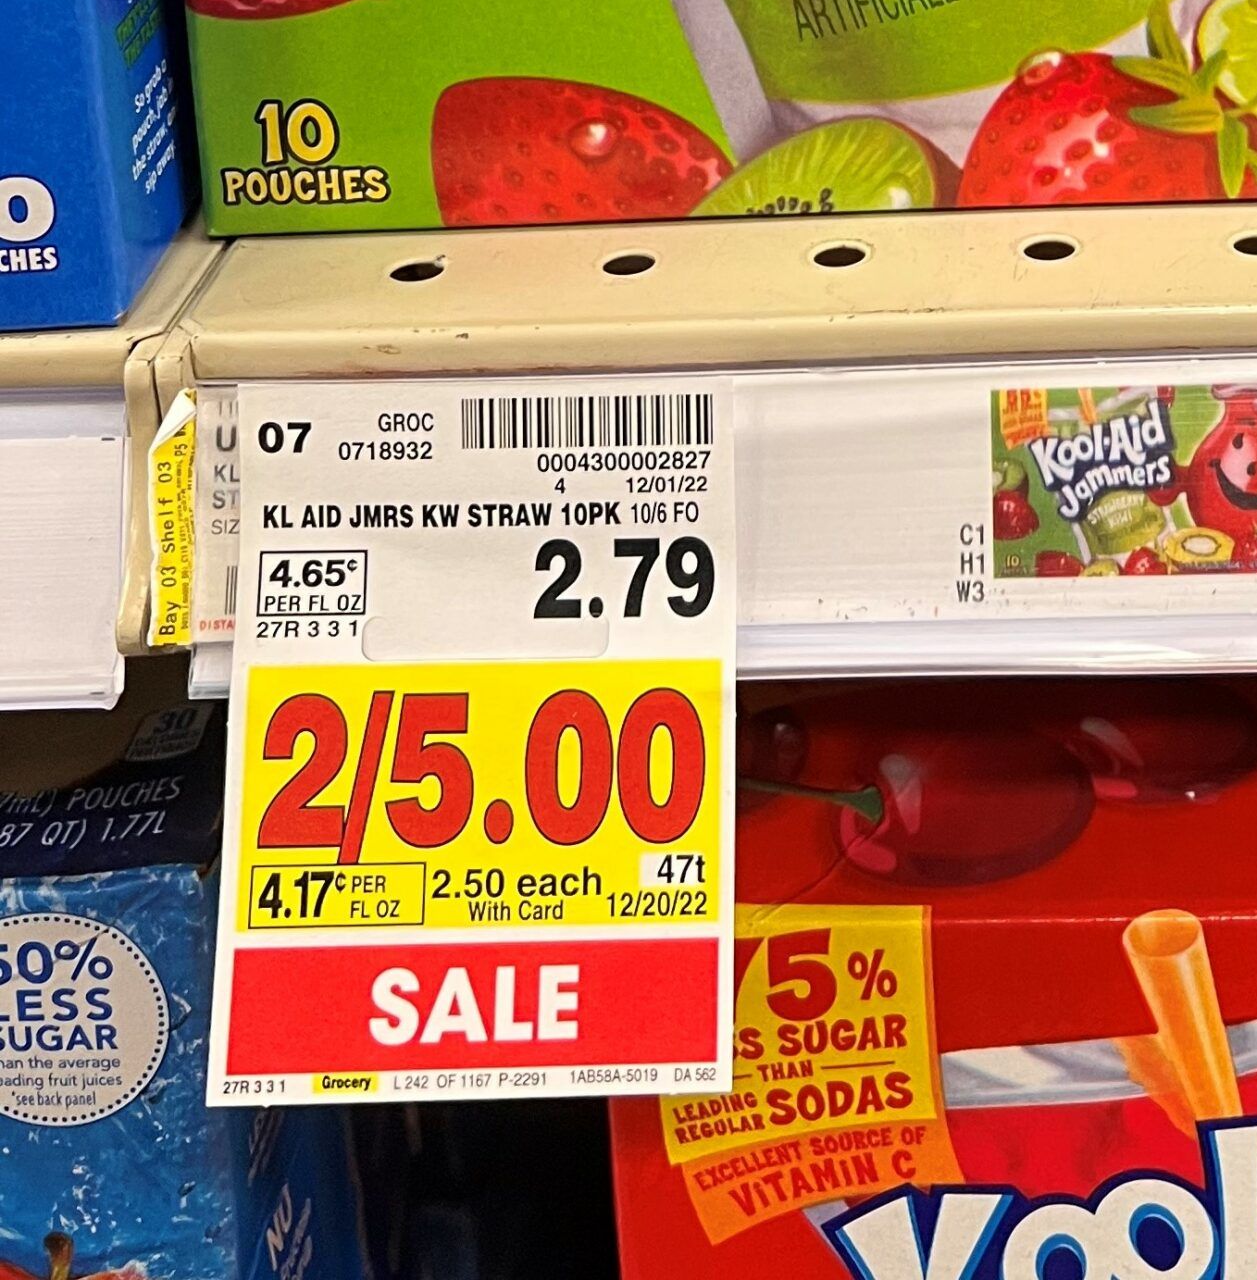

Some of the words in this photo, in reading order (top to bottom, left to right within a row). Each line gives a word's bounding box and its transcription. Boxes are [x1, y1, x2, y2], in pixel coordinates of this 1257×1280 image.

[257, 100, 338, 164] 10
[222, 167, 390, 204] POUCHES
[378, 413, 434, 433] GROC
[257, 422, 312, 454] 07
[1030, 401, 1166, 487] Kool-Aid
[338, 441, 433, 461] 0718932
[537, 451, 710, 472] 0004300002827
[157, 462, 173, 482] 03
[555, 479, 565, 494] 4
[626, 476, 708, 494] 12/01/22
[1059, 454, 1171, 518] Jammers
[158, 497, 175, 554] Shelf
[263, 505, 293, 528] KL
[302, 505, 342, 528] AID
[349, 504, 414, 528] JMRS
[422, 504, 459, 527] KW
[467, 504, 552, 526] STRAW
[561, 503, 621, 525] 10PK
[631, 502, 667, 524] 10/6
[673, 502, 698, 523] FO
[959, 524, 985, 545] C1
[960, 553, 985, 575] H1
[161, 566, 176, 587] 03
[533, 535, 715, 619] 2.79
[264, 595, 302, 612] PER
[309, 595, 330, 612] FL
[337, 594, 362, 611] OZ
[956, 581, 985, 603] W3
[159, 601, 182, 636] Bay
[256, 621, 299, 639] 27R
[307, 621, 320, 638] 3
[328, 621, 340, 638] 3
[350, 621, 358, 637] 1
[256, 688, 706, 865] 2/5.00
[65, 775, 185, 812] POUCHES
[41, 818, 87, 850] QT)
[101, 810, 167, 843] 1.77L
[657, 854, 706, 883] 47t
[352, 876, 386, 893] PER
[431, 869, 505, 900] 2.50
[518, 866, 602, 897] each
[350, 900, 371, 918] FL
[377, 900, 400, 918] OZ
[468, 900, 512, 922] With
[518, 899, 563, 920] Card
[606, 892, 708, 916] 12/20/22
[369, 964, 580, 1045] SALE
[778, 1014, 907, 1058] SUGAR
[28, 1056, 53, 1069] the
[58, 1058, 121, 1071] average
[674, 1068, 692, 1082] DA
[694, 1067, 716, 1082] 562
[757, 1061, 814, 1083] THAN
[48, 1073, 77, 1086] fruit
[82, 1075, 123, 1090] juices
[223, 1080, 250, 1095] 27R
[254, 1080, 263, 1094] 3
[267, 1080, 275, 1094] 3
[278, 1079, 285, 1094] 1
[322, 1074, 371, 1092] Grocery
[394, 1076, 401, 1090] L
[404, 1075, 429, 1089] 242
[436, 1074, 457, 1088] OF
[461, 1073, 491, 1088] 1167
[499, 1071, 547, 1087] P-2291
[37, 1091, 62, 1106] back
[65, 1091, 97, 1110] panel
[766, 1072, 914, 1127] SODAS
[675, 1114, 766, 1145] REGULAR
[694, 1143, 801, 1193] EXCELLENT
[809, 1127, 893, 1157] SOURCE
[902, 1126, 927, 1146] OF
[892, 1150, 916, 1180] C
